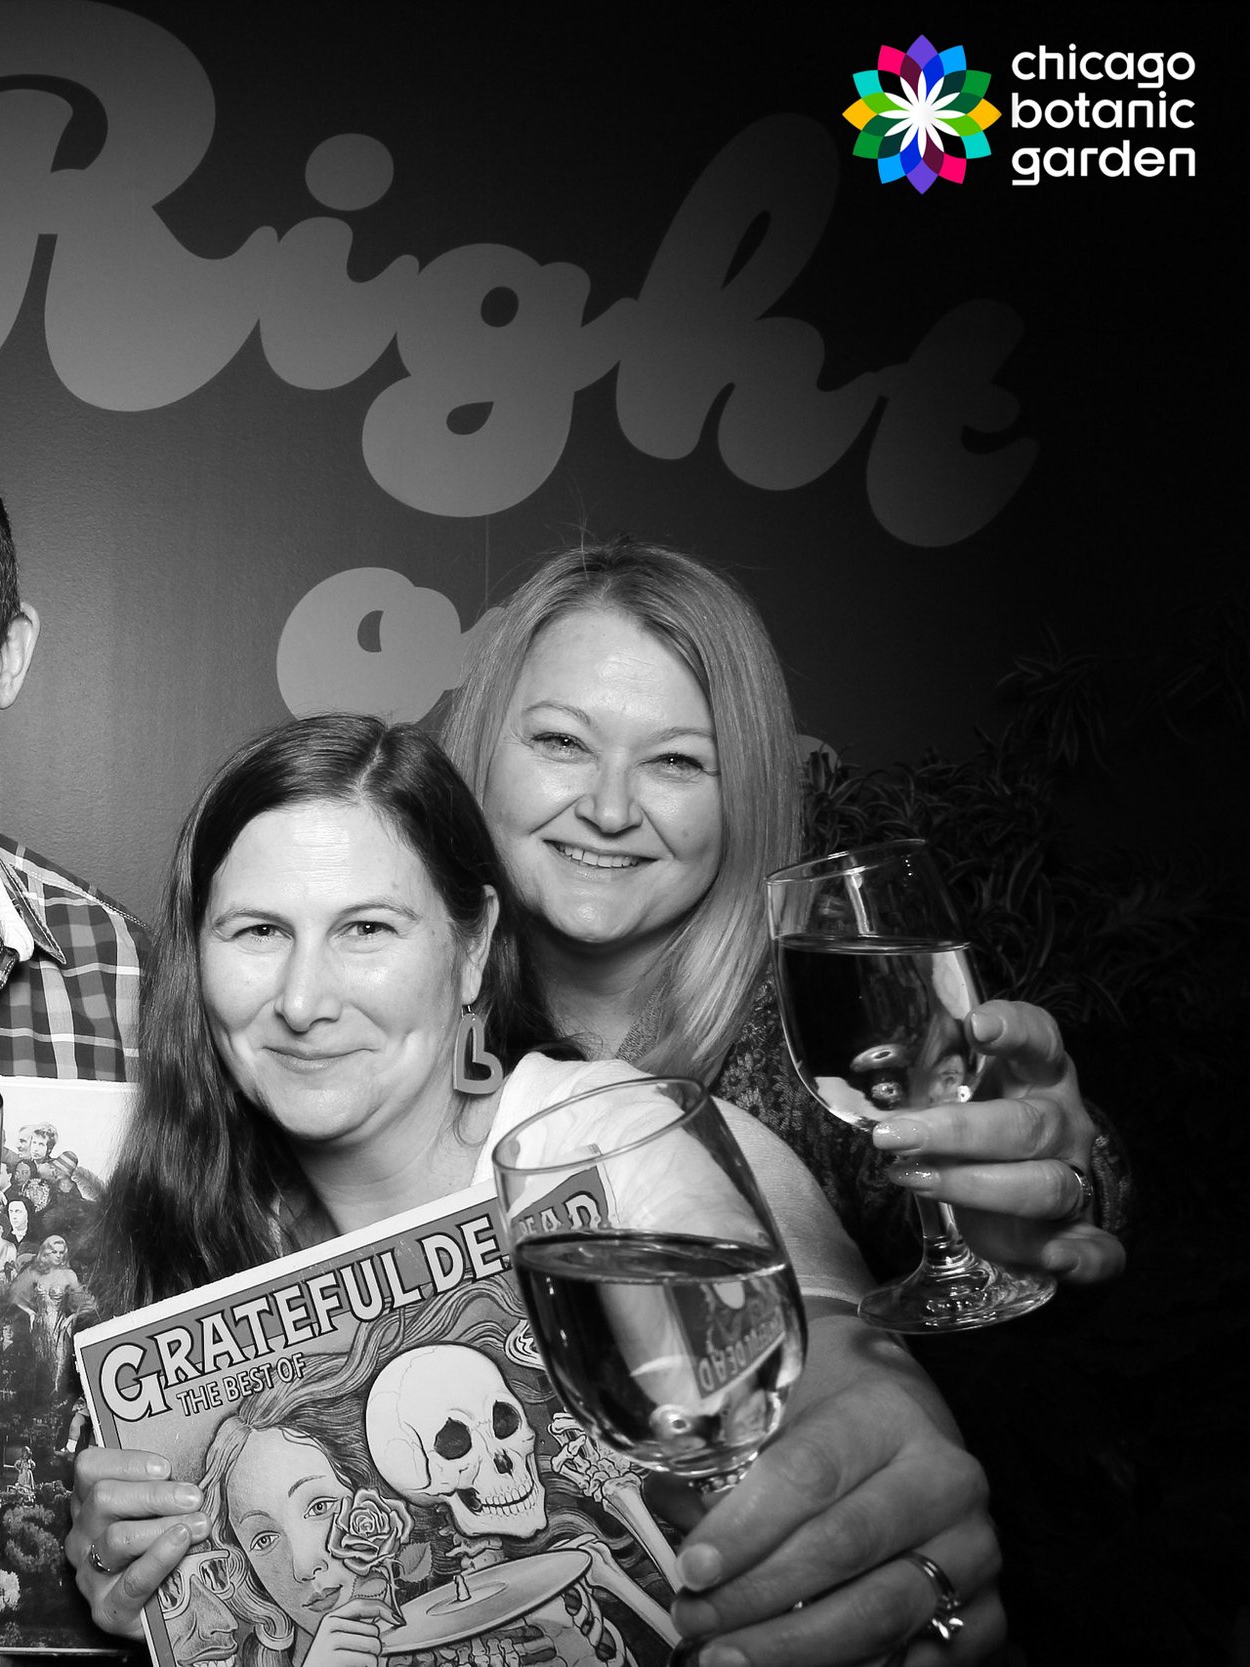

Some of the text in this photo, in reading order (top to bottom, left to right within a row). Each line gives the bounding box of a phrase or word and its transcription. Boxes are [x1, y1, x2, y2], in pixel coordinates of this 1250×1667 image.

[98, 1246, 424, 1422] GRATEFUL
[176, 1351, 306, 1417] THE BEST OF
